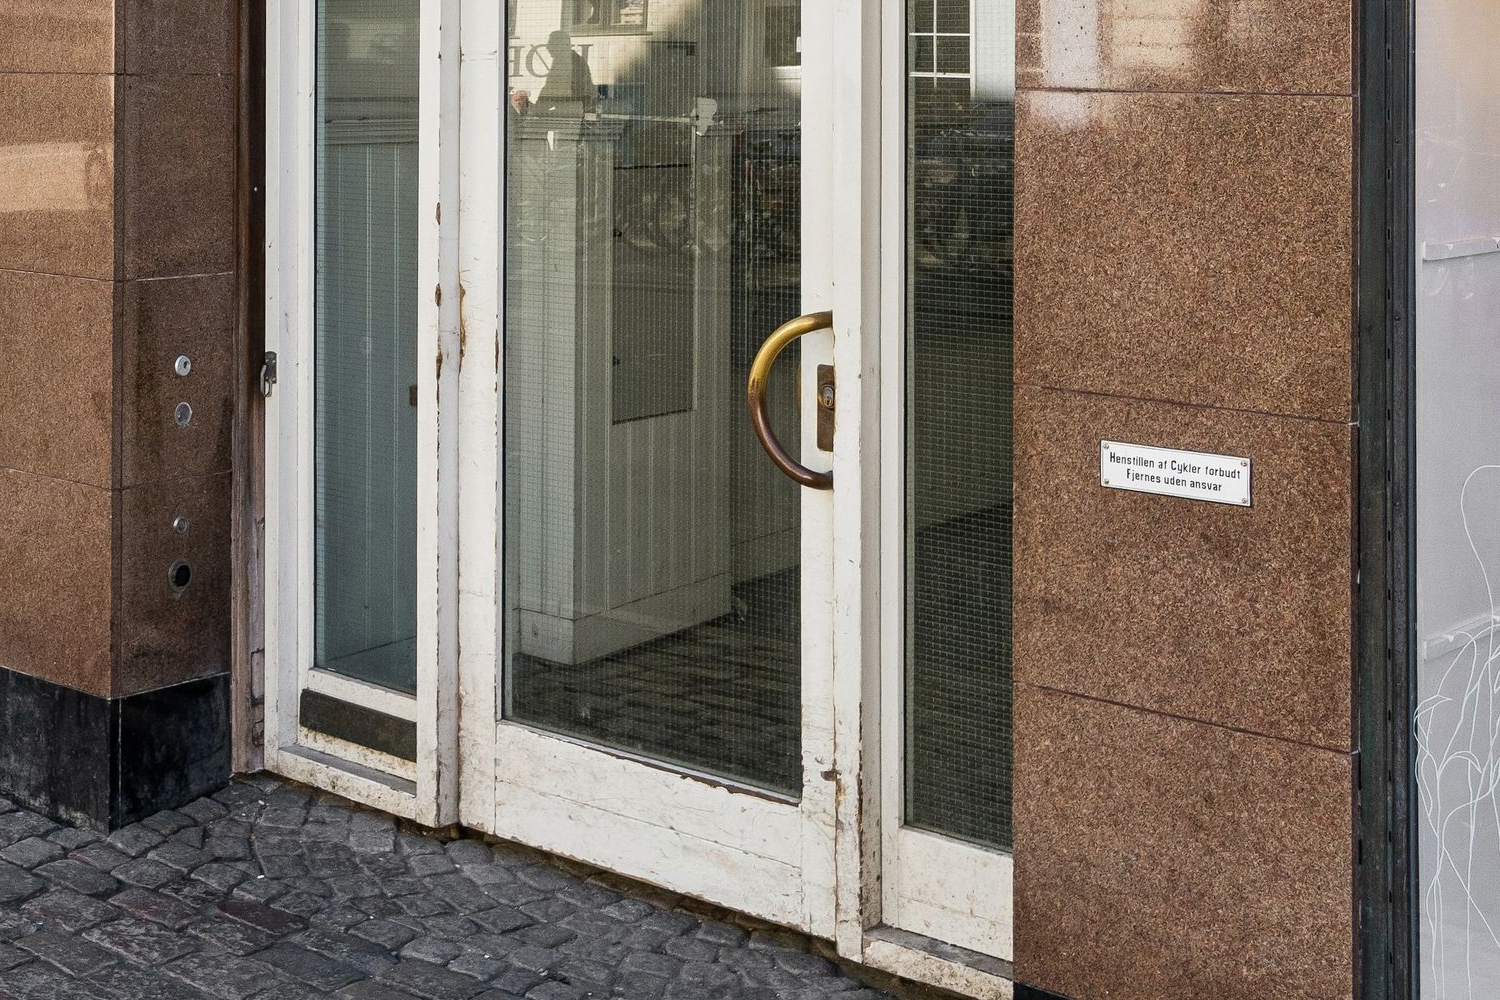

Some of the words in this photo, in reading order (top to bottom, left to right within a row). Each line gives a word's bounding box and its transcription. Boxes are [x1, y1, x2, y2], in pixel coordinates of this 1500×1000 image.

[1109, 451, 1155, 469] Henstillen
[1158, 460, 1167, 470] af
[1170, 460, 1202, 475] Cykler
[1205, 466, 1241, 480] forbudt
[1126, 468, 1161, 484] Fjernes
[1164, 476, 1187, 488] uden
[1189, 480, 1222, 492] ansvar
